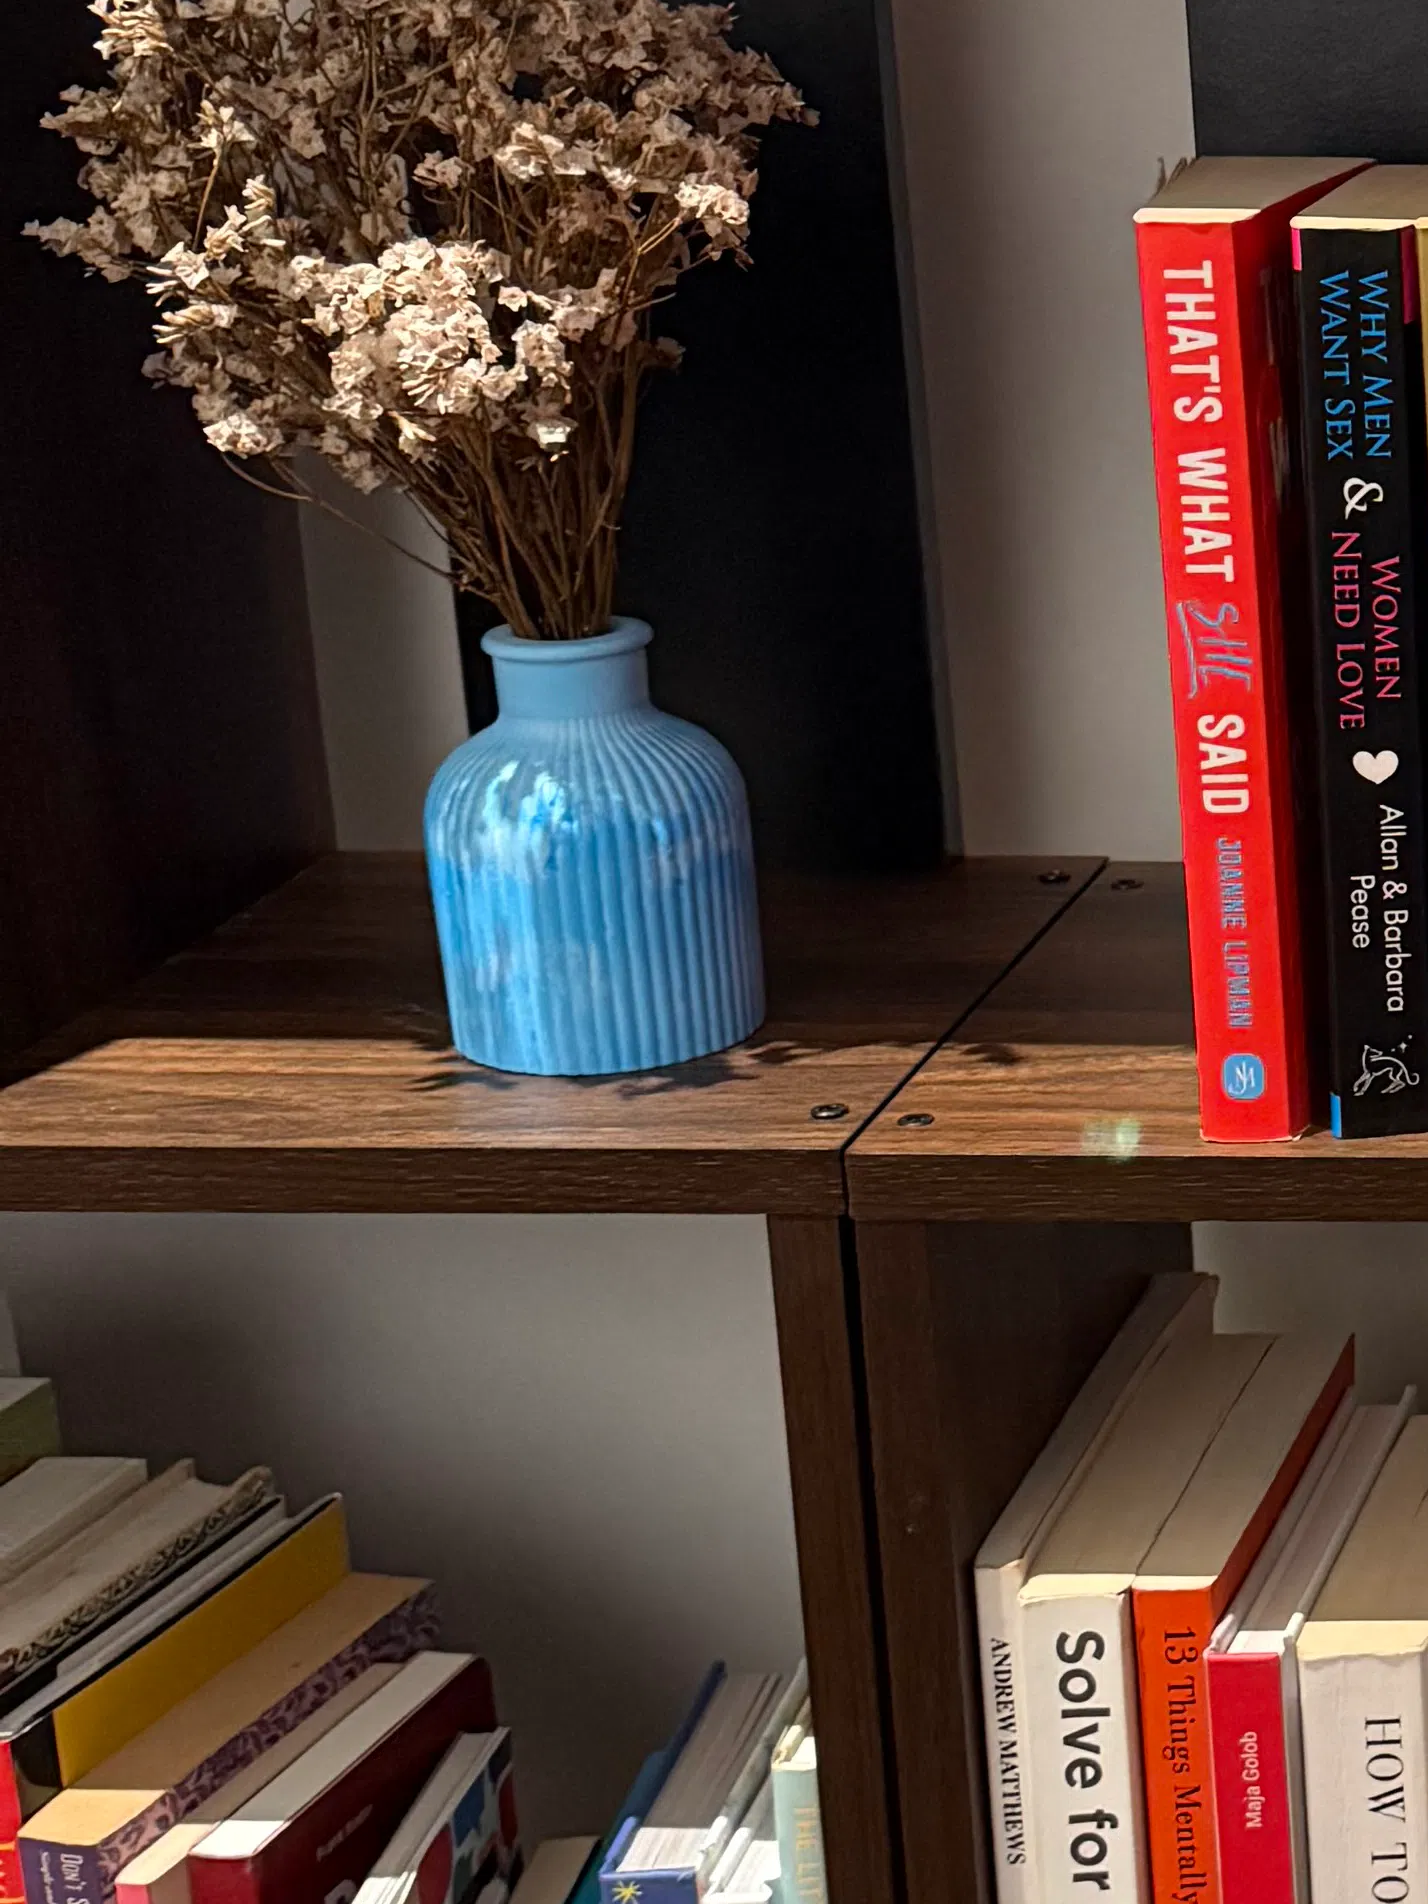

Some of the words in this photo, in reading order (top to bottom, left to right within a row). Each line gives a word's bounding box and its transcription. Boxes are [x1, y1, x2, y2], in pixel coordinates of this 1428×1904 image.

[1163, 261, 1224, 422] THAT'S
[1177, 449, 1235, 582] WHAT
[1193, 714, 1250, 814] SAID
[1218, 837, 1248, 930] JOANNE
[1223, 941, 1252, 1028] LIPMAN
[1164, 1626, 1196, 1664] 13
[1054, 1631, 1111, 1788] Solve
[1160, 1674, 1201, 1773] Things
[1066, 1808, 1117, 1890] for
[1165, 1783, 1208, 1904] Mentally
